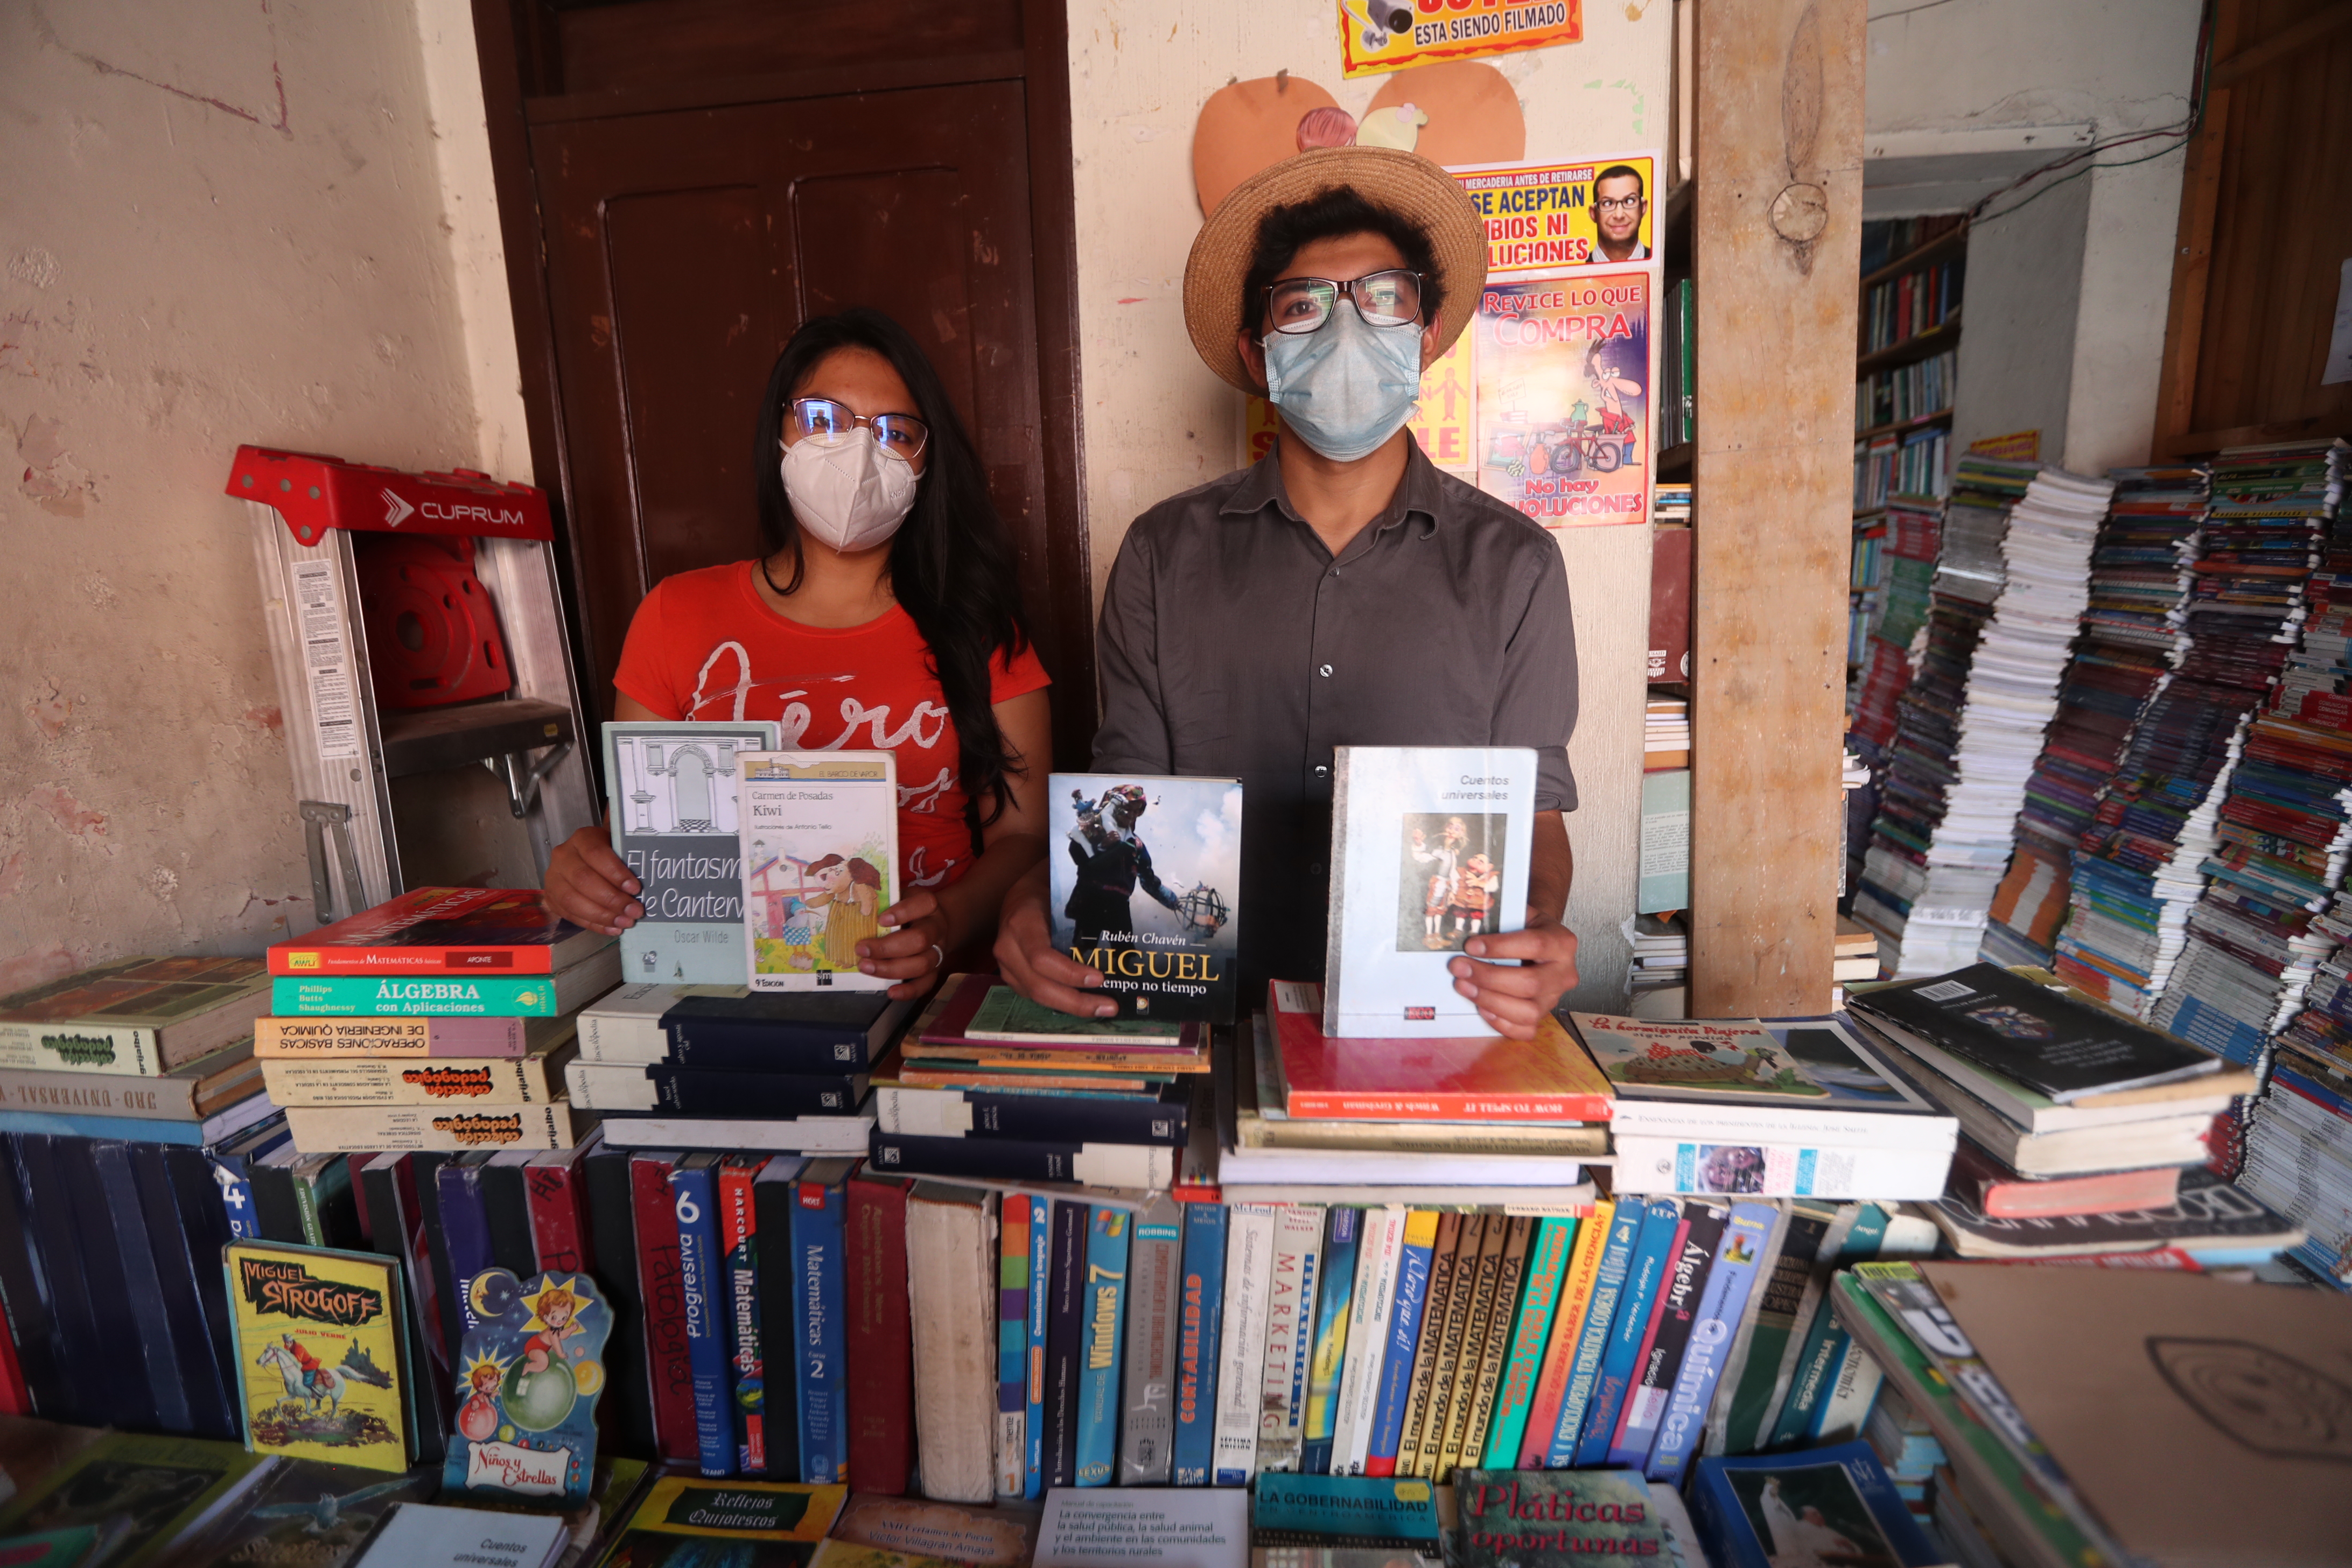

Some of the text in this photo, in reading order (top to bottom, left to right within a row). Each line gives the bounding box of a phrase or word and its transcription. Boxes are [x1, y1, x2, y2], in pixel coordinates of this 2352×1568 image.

[1415, 25, 1447, 45] ESTA
[1450, 17, 1500, 41] SIENDO
[1505, 2, 1565, 32] FILMADO
[1466, 176, 1513, 189] MERCADERIA
[1515, 173, 1538, 186] ANTES
[1539, 172, 1550, 184] DE
[1551, 169, 1593, 183] RETIRARSE
[1499, 185, 1585, 213] ACEPTAN
[1546, 213, 1569, 236] NI
[1488, 237, 1589, 268] LUCIONES
[1483, 285, 1641, 313] REVICE LO QUE
[1494, 312, 1632, 346] COMPRA
[1525, 477, 1599, 494] No hay
[421, 501, 524, 526] CUPRUM
[2318, 699, 2349, 710] COMUNICAR
[2318, 705, 2349, 716] COMUNICAR
[2307, 717, 2339, 728] COMUNICAR
[1460, 775, 1510, 786] Cuentos
[752, 791, 833, 800] Carmen de Posadas
[1441, 789, 1509, 801] universales
[753, 804, 782, 816] Kiwi
[649, 849, 742, 887] fantasm
[661, 887, 744, 918] Canterv
[327, 890, 486, 946] MATEMÁTICAS
[675, 930, 728, 943] Oscar Wilde
[1101, 930, 1138, 943] Rubén
[1069, 946, 1220, 982] MIGUEL
[299, 985, 332, 994] Phillips
[375, 979, 481, 999] ÁLGEBRA
[1142, 982, 1159, 991] no
[1162, 980, 1207, 997] tiempo
[299, 1004, 355, 1012] Shaughnessy
[376, 1002, 485, 1013] con Aplicaciones
[280, 1024, 424, 1038] DE INGENIERÍA QUÍMICA
[1588, 1017, 1762, 1037] La hormiguita Viajera
[279, 1038, 425, 1051] OPERACIONES BÁSICAS
[590, 1019, 601, 1061] Enciclopedia
[132, 1030, 148, 1075] grijalbo
[402, 1068, 490, 1084] pedagógica
[17, 1086, 111, 1107] UNIVERSAL
[425, 1083, 491, 1097] colección
[1463, 1102, 1563, 1114] HOW TO SPELL IT
[432, 1115, 519, 1132] pedagógica
[543, 1107, 559, 1150] grijalbo
[454, 1131, 521, 1145] colección
[223, 1183, 246, 1209] 4
[802, 1195, 821, 1207] HOLT
[676, 1191, 699, 1224] 6
[1033, 1206, 1046, 1224] 2
[1234, 1204, 1272, 1215] McLeod
[734, 1187, 747, 1262] HARCOURT
[1138, 1228, 1177, 1238] ROBBINS
[244, 1257, 318, 1294] MIGUEL
[681, 1233, 702, 1338] Progresiva
[261, 1280, 382, 1325] STROGOFF
[807, 1243, 826, 1346] Matemáticas
[733, 1269, 755, 1373] Matemáticas
[294, 1328, 347, 1340] JULIO VERNE
[1089, 1263, 1123, 1423] MANUAL DE Windows 7
[1180, 1273, 1202, 1424] CONTABILIDAD
[1404, 1250, 1454, 1451] El mundo de la MATEMATICA
[1425, 1255, 1476, 1455] El mundo de la MATEMATICA
[1446, 1252, 1499, 1454] El mundo de la MATEMATICA
[1466, 1254, 1522, 1457] El mundo de la MATEMATICA
[810, 1360, 824, 1378] 2
[1659, 1318, 1728, 1452] Química
[474, 1446, 522, 1474] Niños y
[502, 1466, 557, 1486] Estrellas
[711, 1492, 776, 1510] Reflejos
[1259, 1491, 1429, 1512] LA GOBERNABILIDAD
[1472, 1480, 1647, 1523] Pláticas
[689, 1508, 778, 1529] Quijotescos
[1059, 1509, 1165, 1523] La convergencia entre
[905, 1522, 949, 1538] Certamen
[1057, 1522, 1213, 1534] la salud pública, la salud animal
[478, 1537, 528, 1555] Cuentos
[1054, 1533, 1226, 1545] y el ambiente en las comunidades
[1472, 1528, 1661, 1557] oportunas
[452, 1551, 519, 1568] universales
[1052, 1544, 1163, 1556] y los territorios rurales
